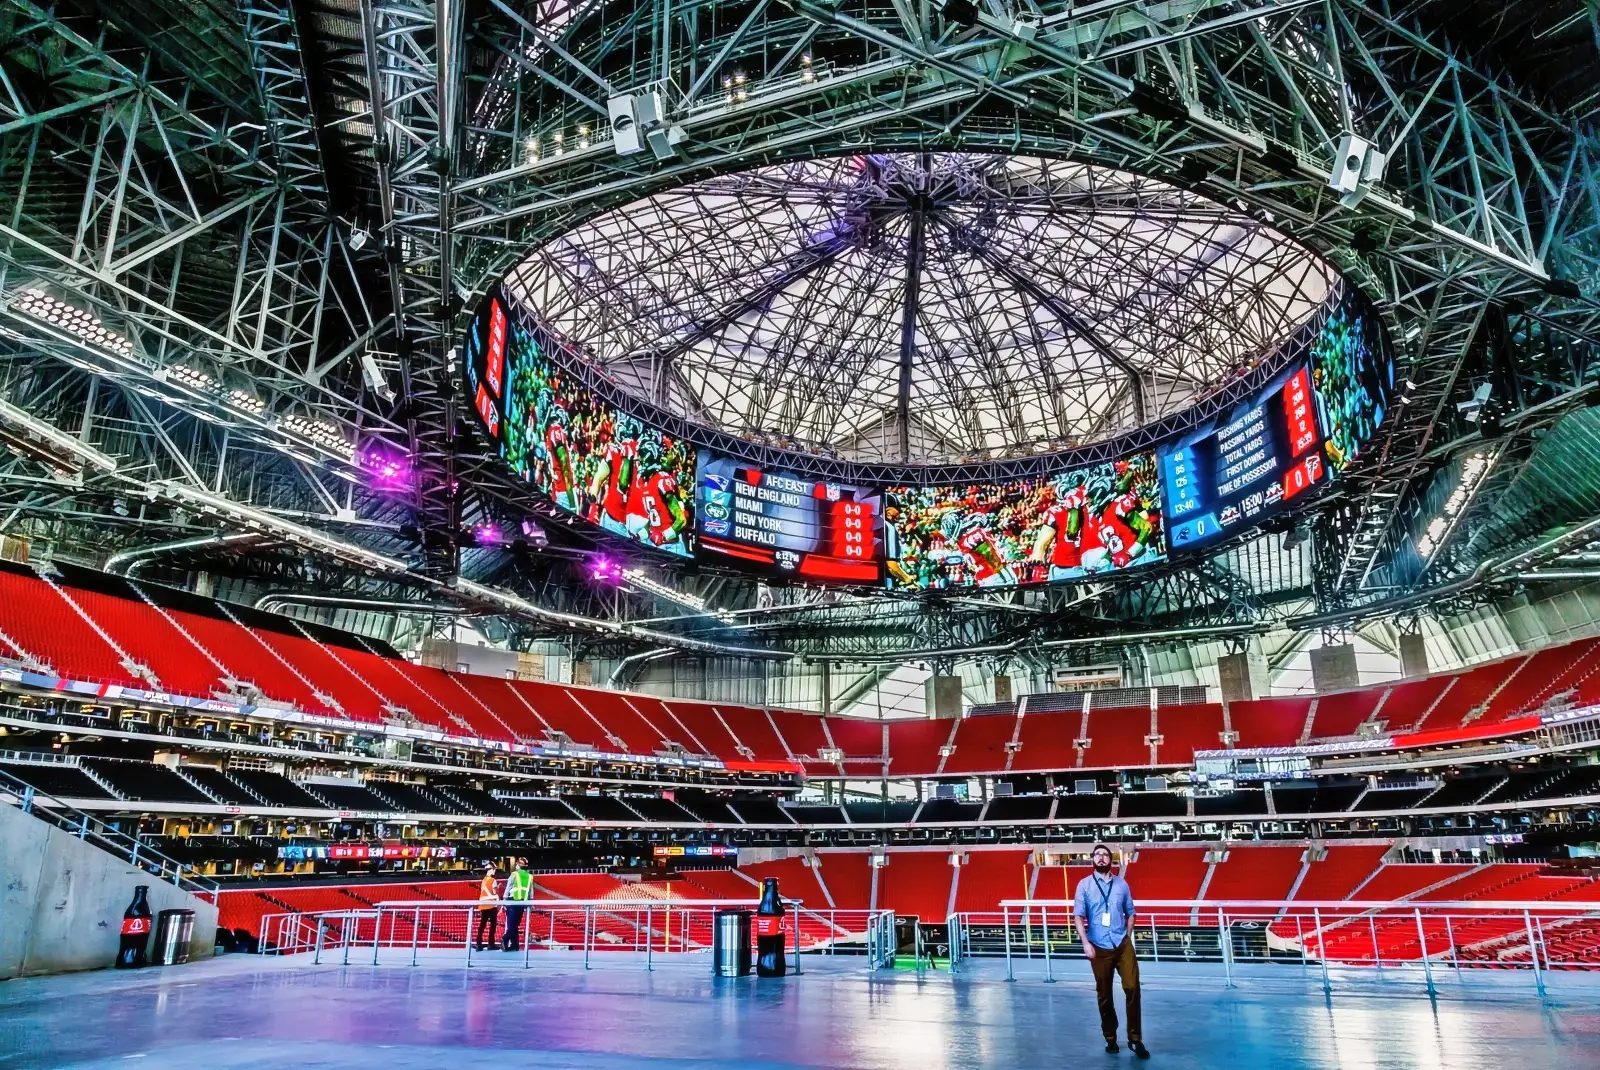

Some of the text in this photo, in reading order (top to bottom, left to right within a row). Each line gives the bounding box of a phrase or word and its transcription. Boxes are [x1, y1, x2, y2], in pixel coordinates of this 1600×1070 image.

[1218, 406, 1263, 441] RUSHING YARDS
[1220, 420, 1265, 454] PASSING YARDS
[1225, 436, 1263, 464] TOTAL YARDS
[1226, 449, 1265, 478] FIRST DOWNS
[766, 475, 808, 494] AFC EAST
[1218, 457, 1278, 496] TIME OF POSSESSION
[1295, 470, 1303, 488] 0
[735, 482, 799, 506] NEW ENGLAND
[1241, 491, 1263, 511] 15:00
[735, 497, 763, 513] MIAMI
[845, 504, 861, 515] 0-0
[735, 511, 782, 531] NEW YORK
[845, 517, 861, 529] 0-0
[1197, 520, 1205, 535] 0
[735, 526, 775, 545] BUFFALO
[845, 531, 862, 543] 0-0
[846, 545, 862, 556] 0-0
